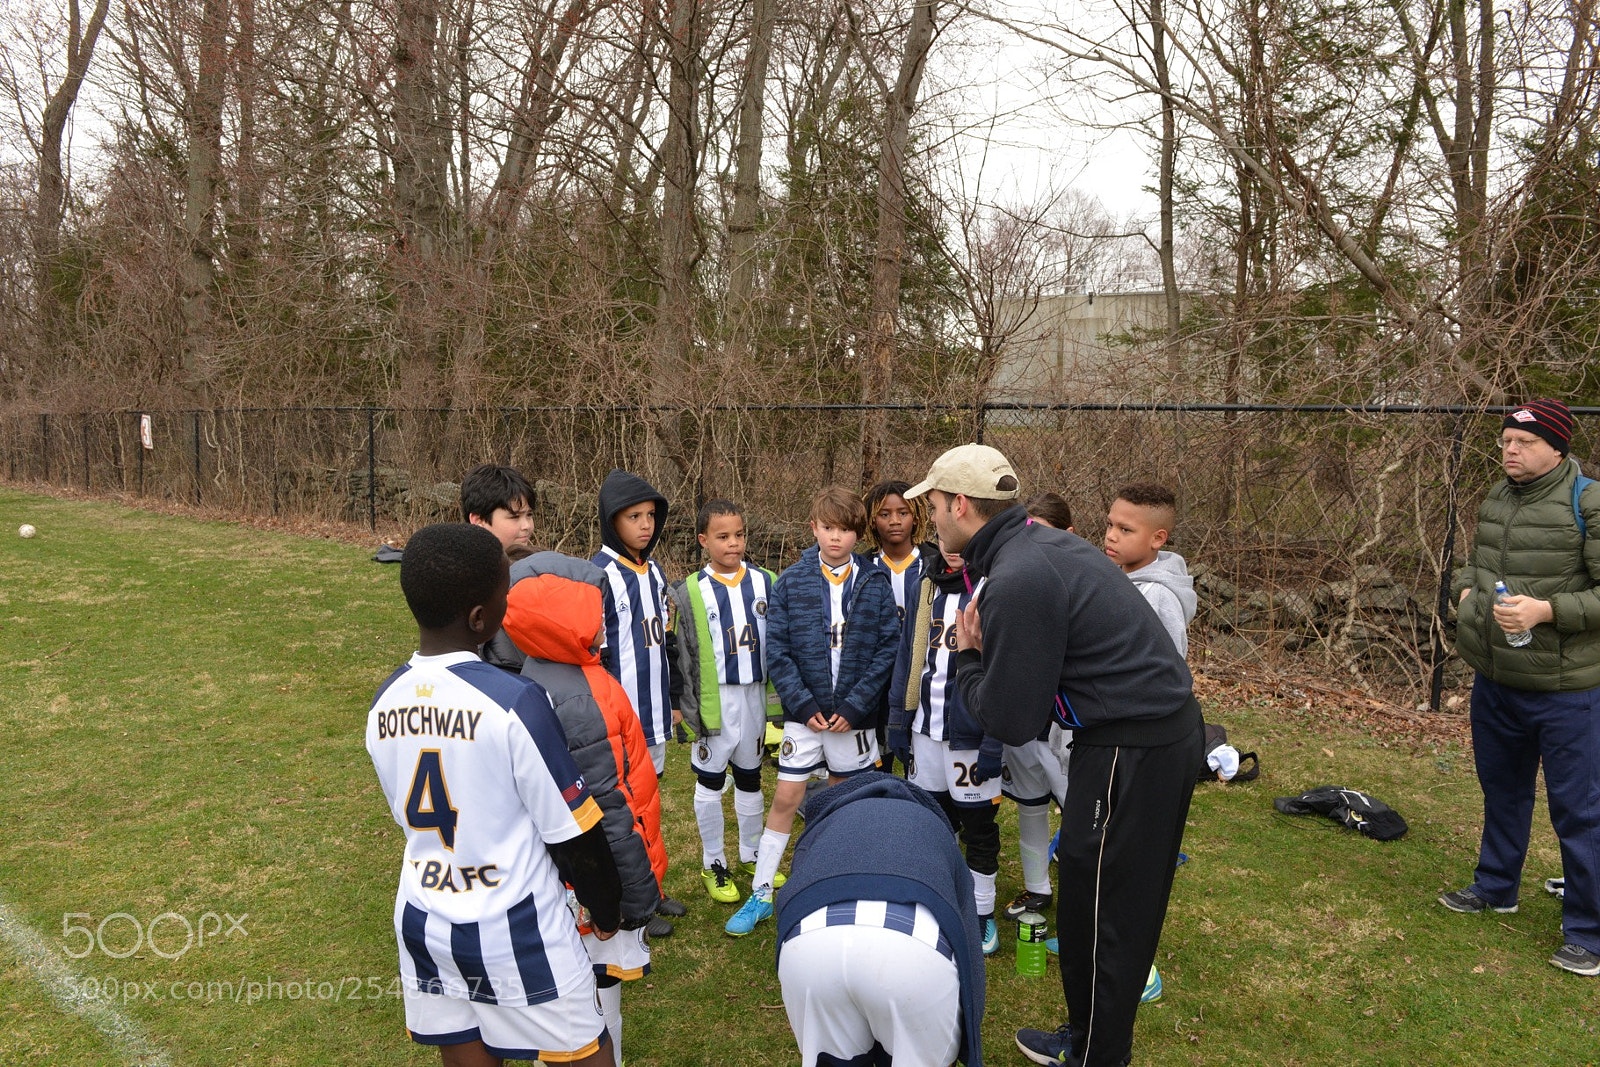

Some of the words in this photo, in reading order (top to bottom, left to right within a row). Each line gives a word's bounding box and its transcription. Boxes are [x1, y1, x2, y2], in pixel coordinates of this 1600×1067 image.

[641, 615, 664, 648] 10
[727, 623, 757, 654] 14
[930, 618, 959, 652] 26
[378, 704, 483, 742] BOTCHWAY
[854, 729, 871, 757] 11
[404, 748, 459, 853] 4
[409, 859, 461, 893] BA
[457, 864, 502, 892] FC
